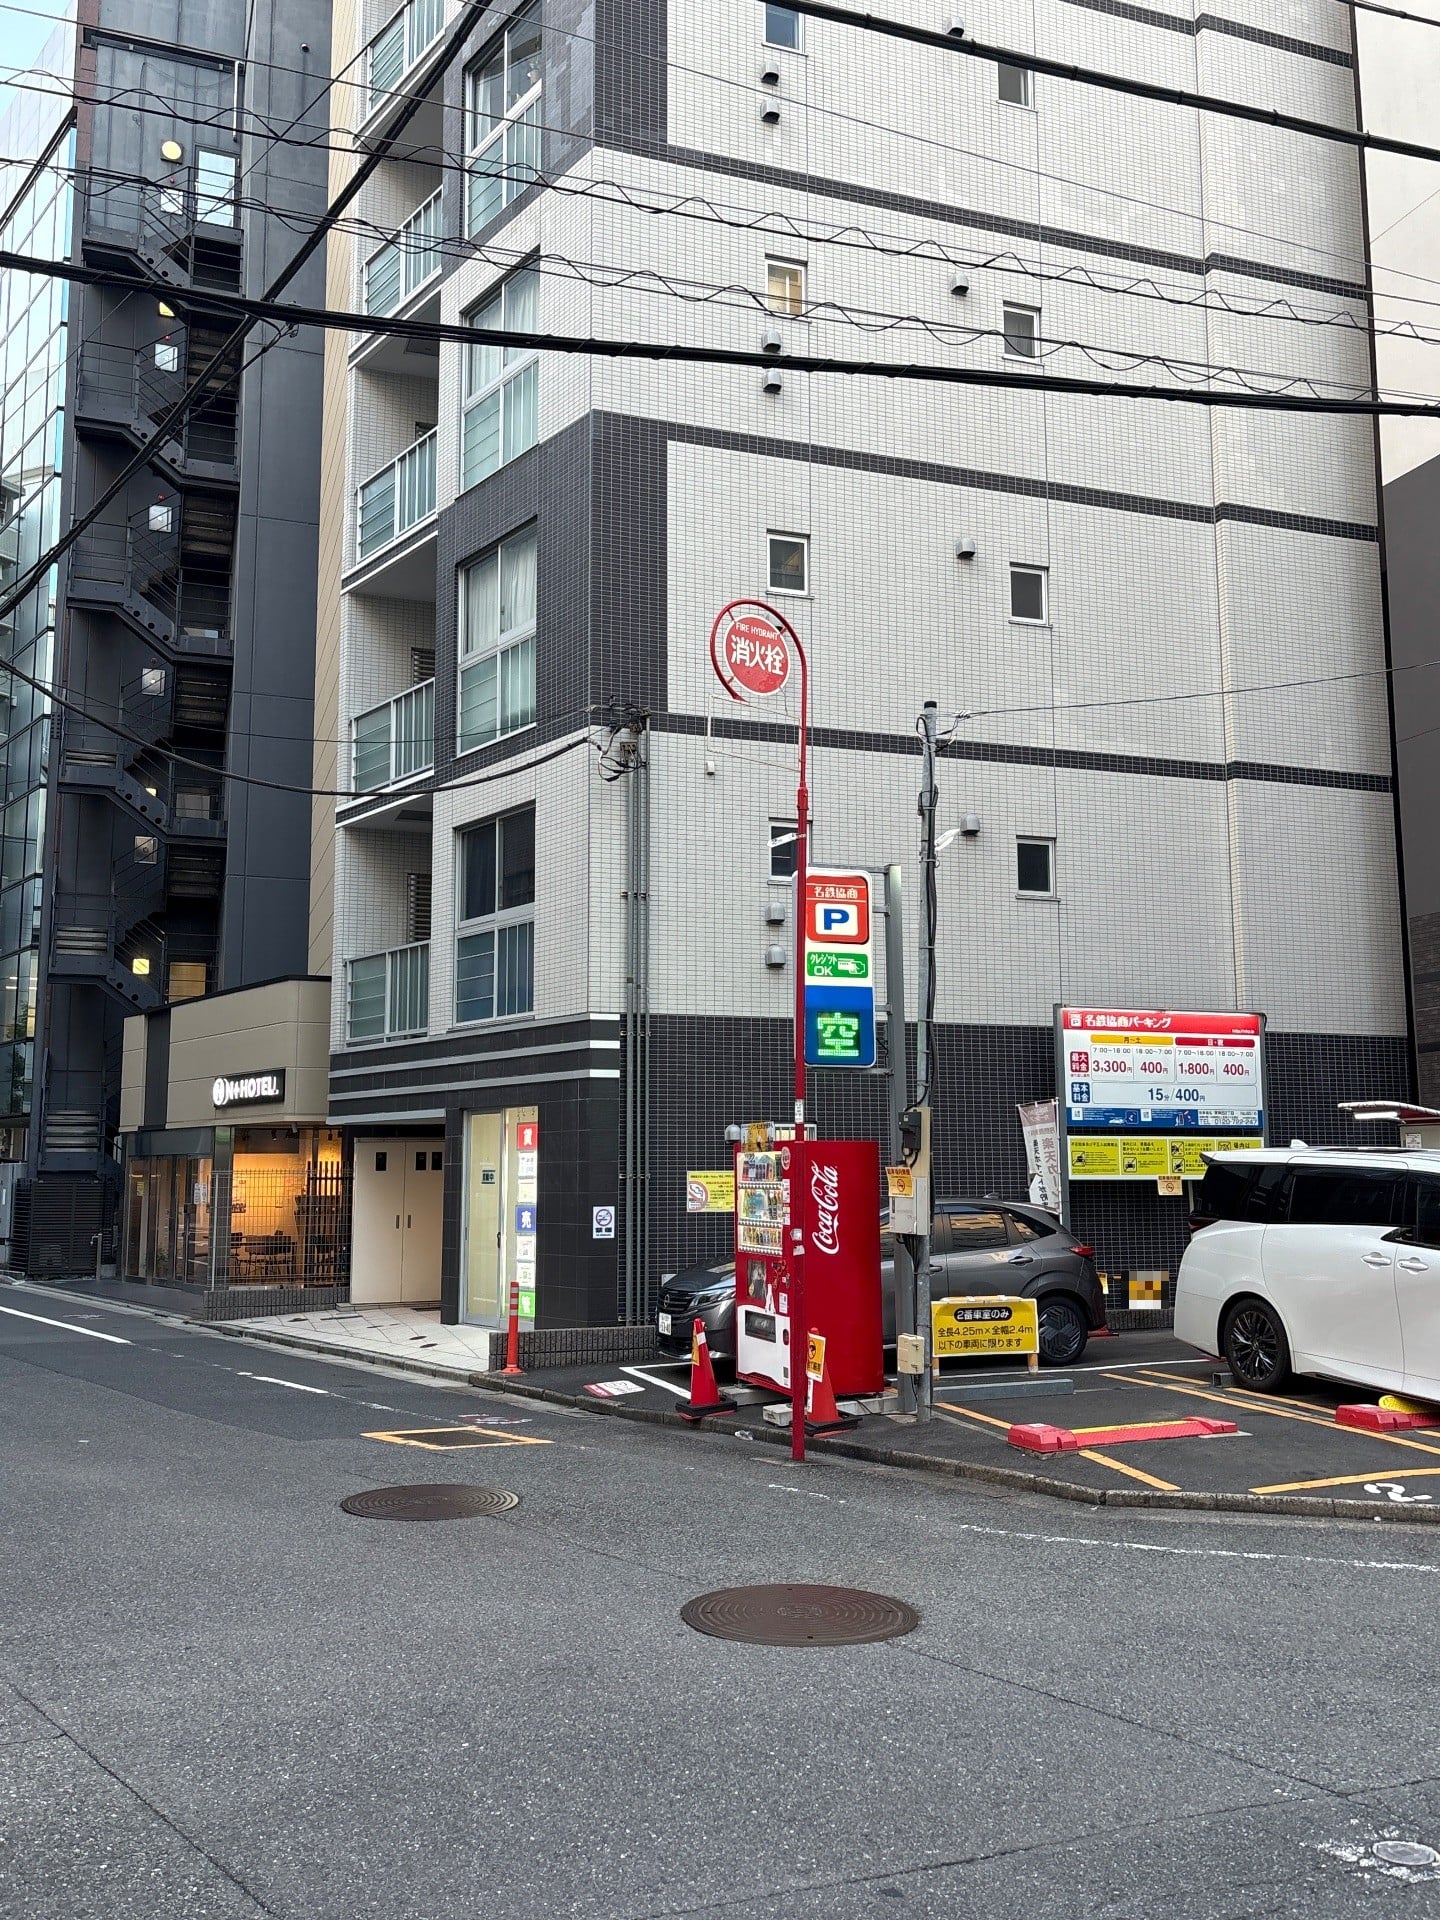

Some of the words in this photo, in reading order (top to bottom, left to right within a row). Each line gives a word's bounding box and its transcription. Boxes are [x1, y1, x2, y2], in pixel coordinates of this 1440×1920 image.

[736, 622, 750, 633] FIRE
[751, 626, 779, 640] HYDRANT
[731, 635, 784, 676] 消火栓
[814, 886, 858, 899] 名鉄協商
[823, 908, 850, 931] P
[810, 954, 837, 965] クレジット
[814, 966, 833, 976] OK
[1085, 1015, 1171, 1029] 名鉄協商パーキング
[817, 1012, 859, 1056] 空
[1071, 1053, 1088, 1062] 最大
[1071, 1062, 1088, 1071] 料金
[1073, 1093, 1089, 1102] 料金
[811, 1160, 840, 1255] Coca-Cola
[956, 1309, 1010, 1320] 2番車室のみ
[938, 1338, 1023, 1350] 以下の車両に限ります
